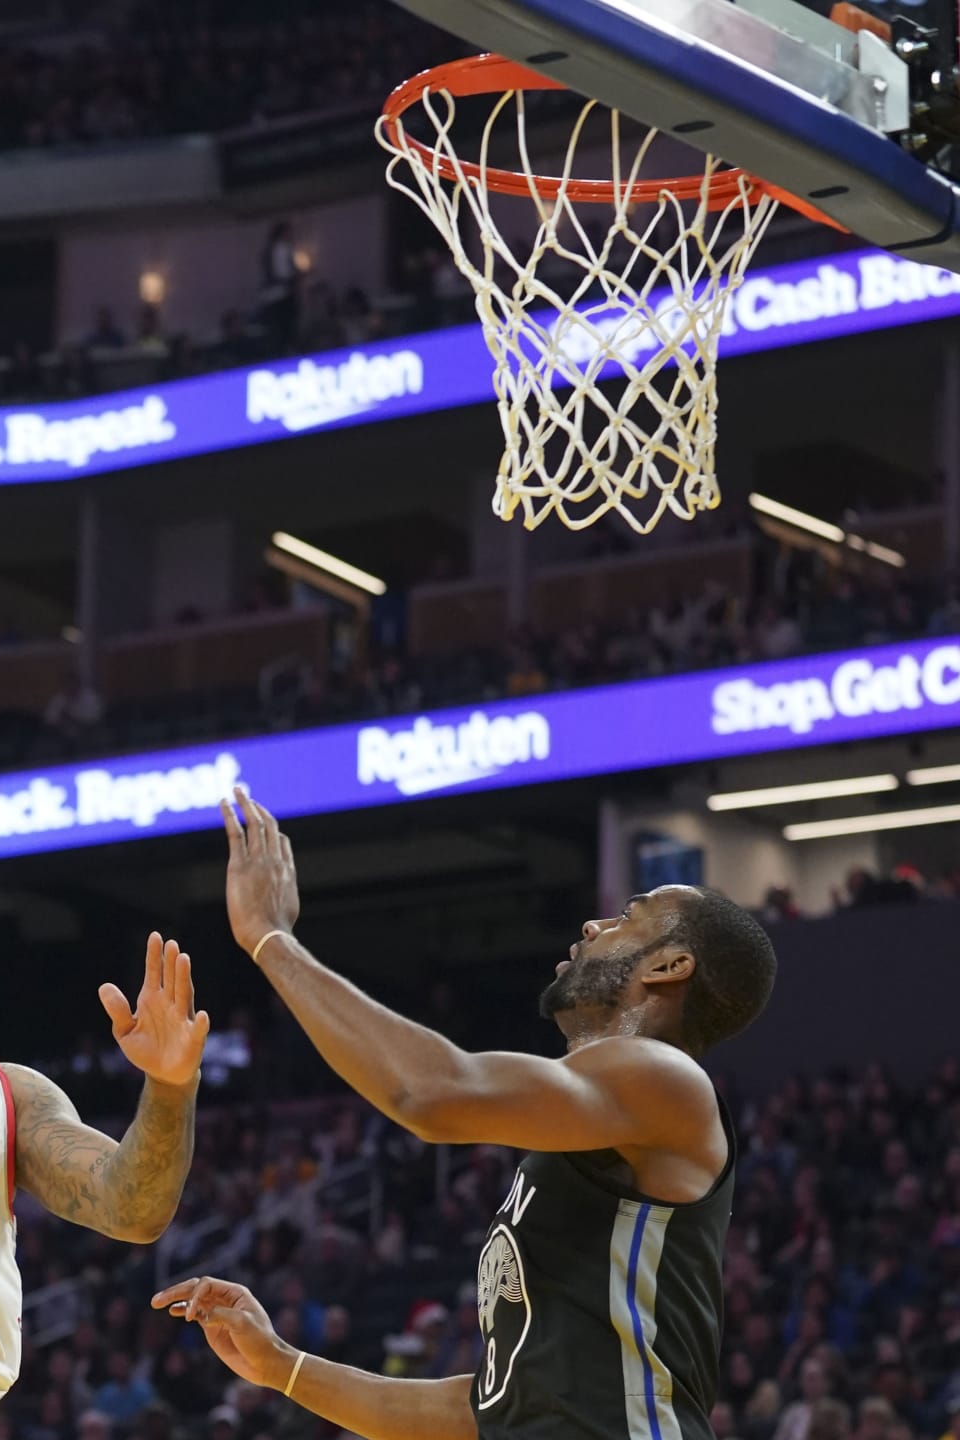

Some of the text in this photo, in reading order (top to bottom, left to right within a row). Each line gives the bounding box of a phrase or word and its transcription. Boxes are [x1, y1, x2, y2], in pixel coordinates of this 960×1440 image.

[736, 264, 859, 332] Cash
[858, 255, 960, 310] Bac
[246, 350, 424, 432] Rakuten
[711, 678, 836, 735] Shop.
[831, 658, 924, 718] Get
[357, 711, 550, 795] Rakuten
